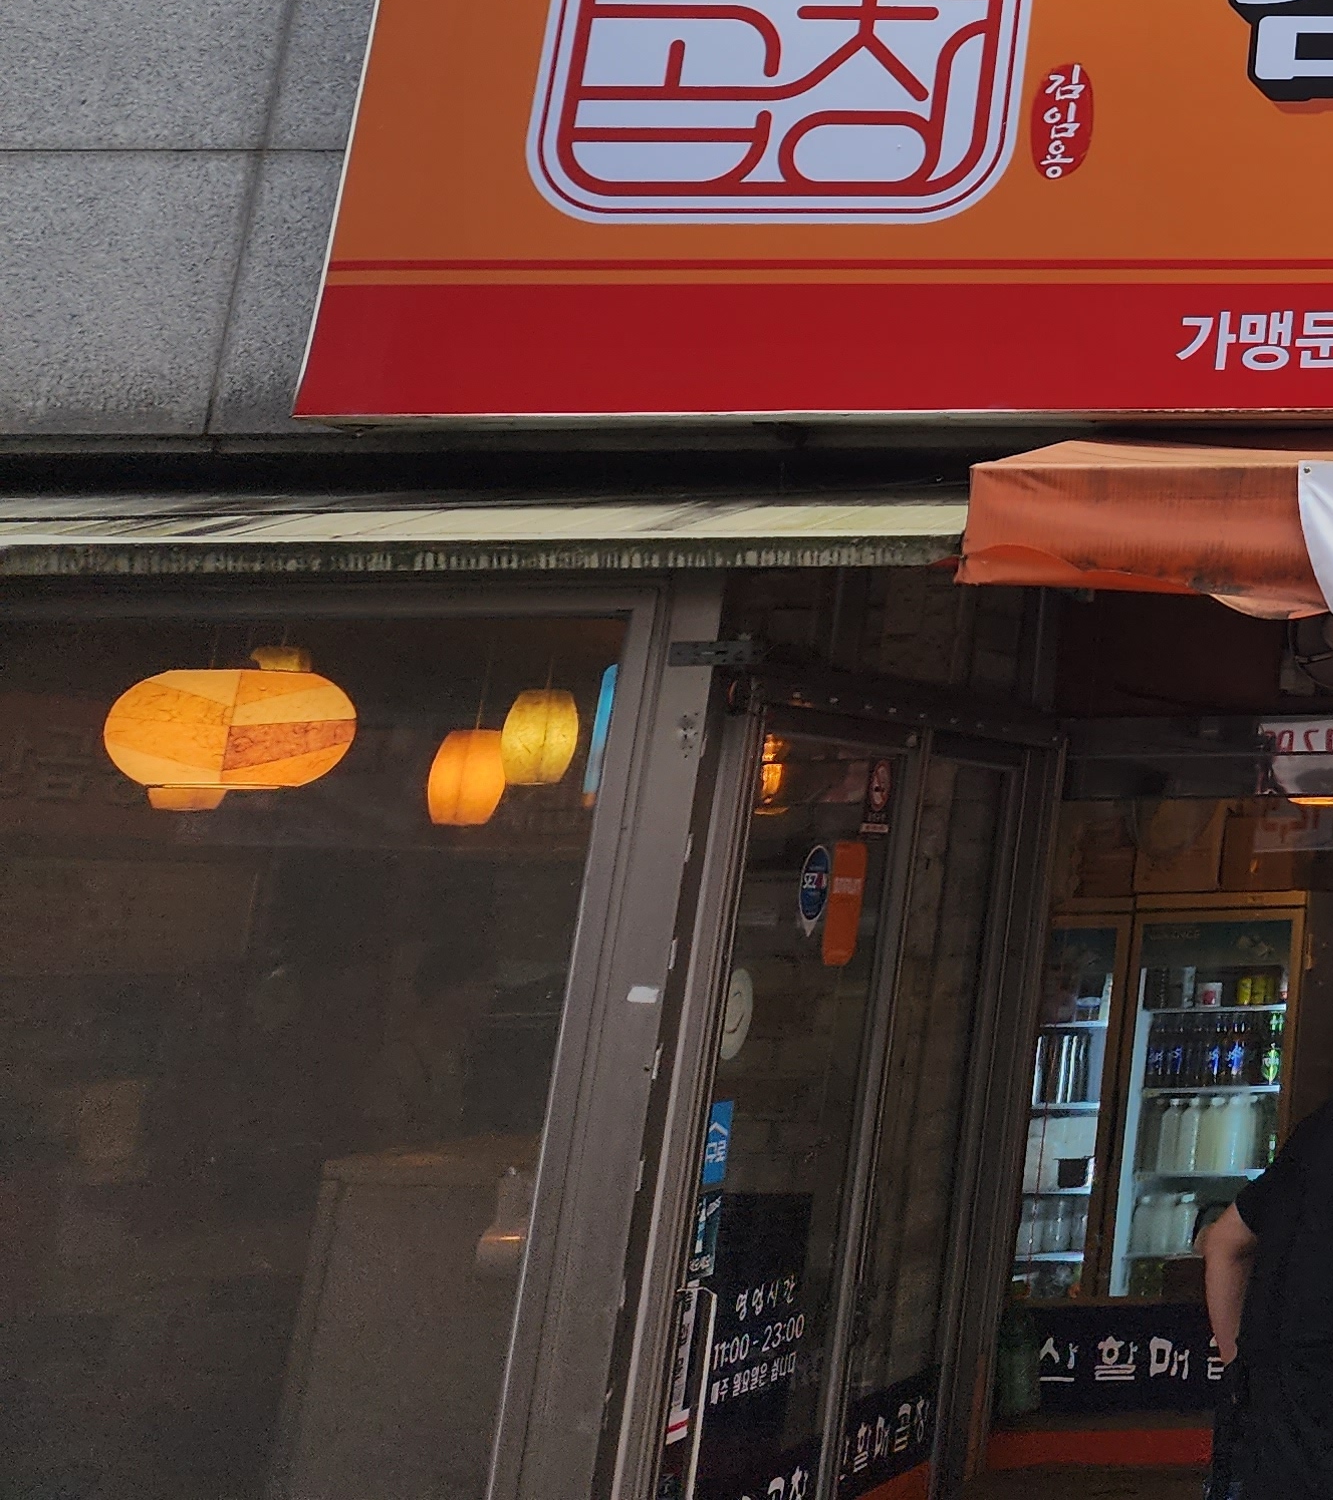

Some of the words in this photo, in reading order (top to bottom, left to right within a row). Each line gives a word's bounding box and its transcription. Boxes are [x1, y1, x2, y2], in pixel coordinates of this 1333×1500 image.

[1038, 62, 1087, 181] 김임용
[735, 1273, 796, 1322] 영업시간
[712, 1332, 751, 1371] 11:00
[761, 1313, 806, 1353] 23:00
